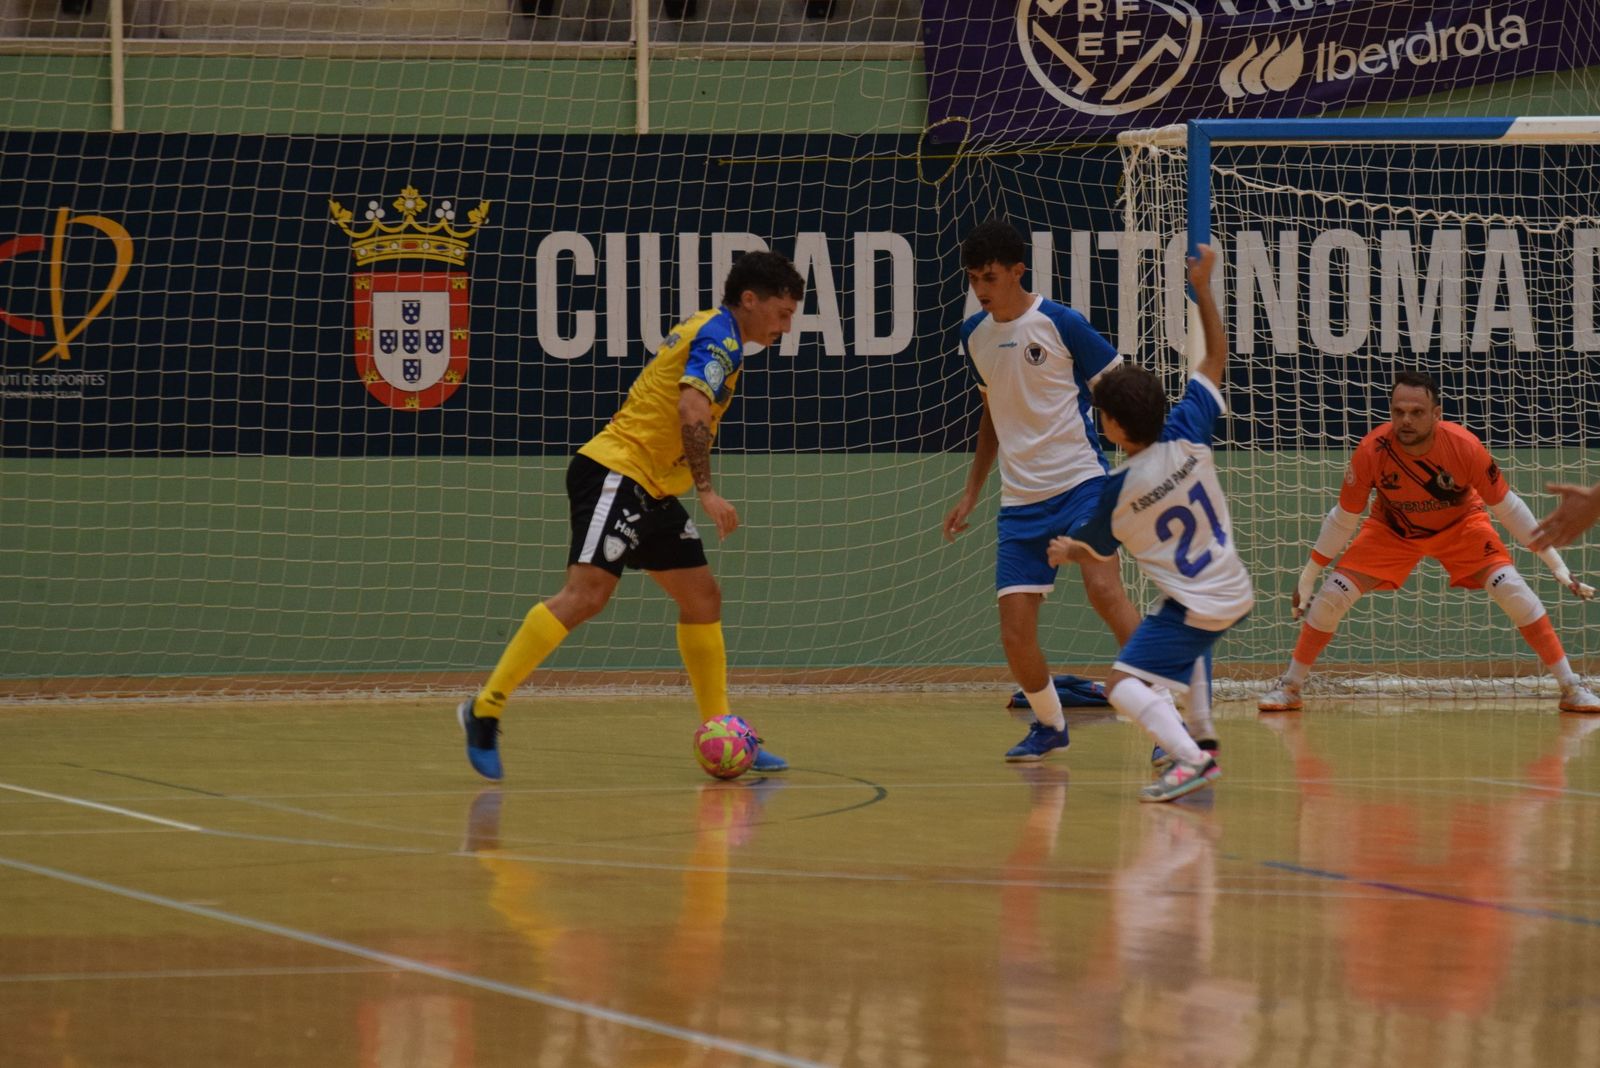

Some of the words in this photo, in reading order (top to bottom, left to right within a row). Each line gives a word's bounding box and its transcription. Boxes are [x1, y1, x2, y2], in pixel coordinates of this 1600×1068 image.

[1315, 8, 1528, 83] Iberdrola
[957, 228, 1538, 356] UTONOMA
[22, 374, 40, 386] DE
[42, 374, 105, 386] DEPORTES
[1155, 480, 1227, 579] 21
